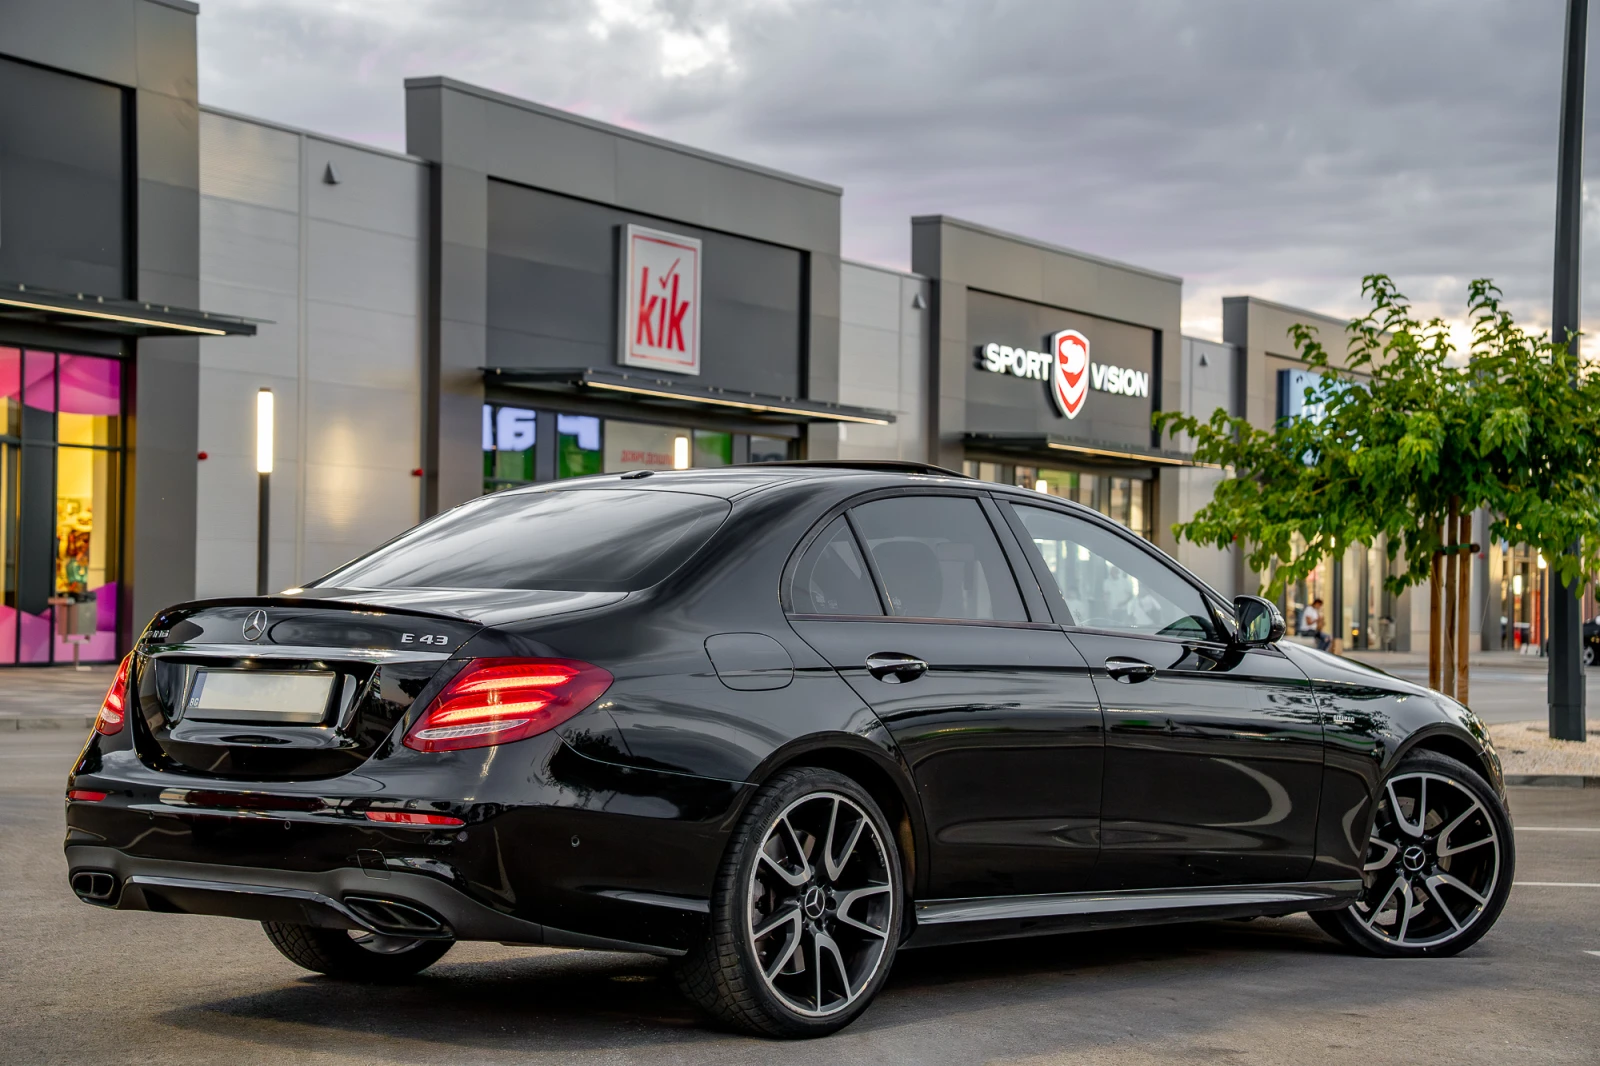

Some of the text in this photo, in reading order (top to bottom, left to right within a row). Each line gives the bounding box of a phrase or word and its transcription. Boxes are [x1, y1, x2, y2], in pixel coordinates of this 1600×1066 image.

[984, 343, 1149, 398] SPORT VISION
[401, 633, 449, 645] E 43
